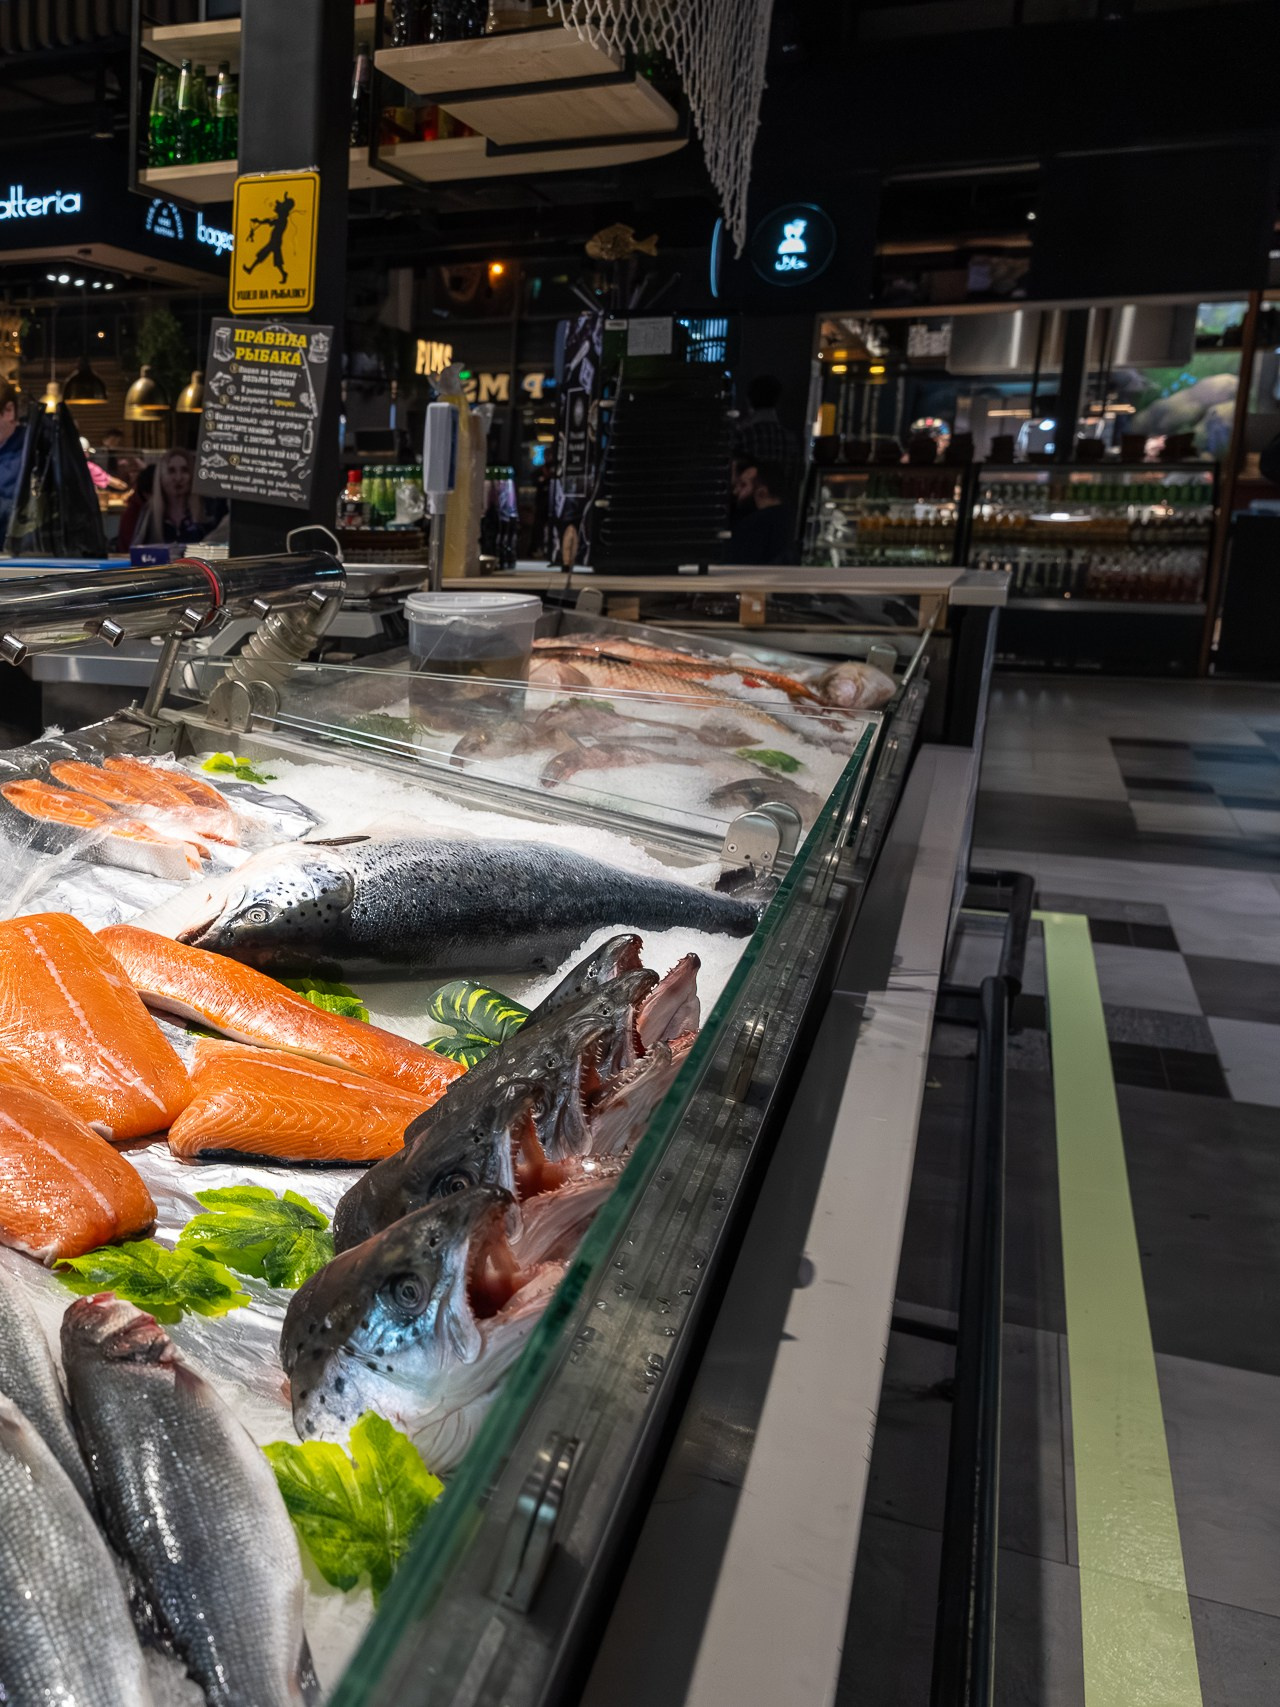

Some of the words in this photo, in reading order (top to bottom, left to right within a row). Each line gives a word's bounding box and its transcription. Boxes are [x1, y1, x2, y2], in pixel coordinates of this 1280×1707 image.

[270, 288, 306, 299] РЫБАЛКУ
[234, 329, 307, 348] ПРАВИЛА
[235, 347, 301, 365] РЫБАКА
